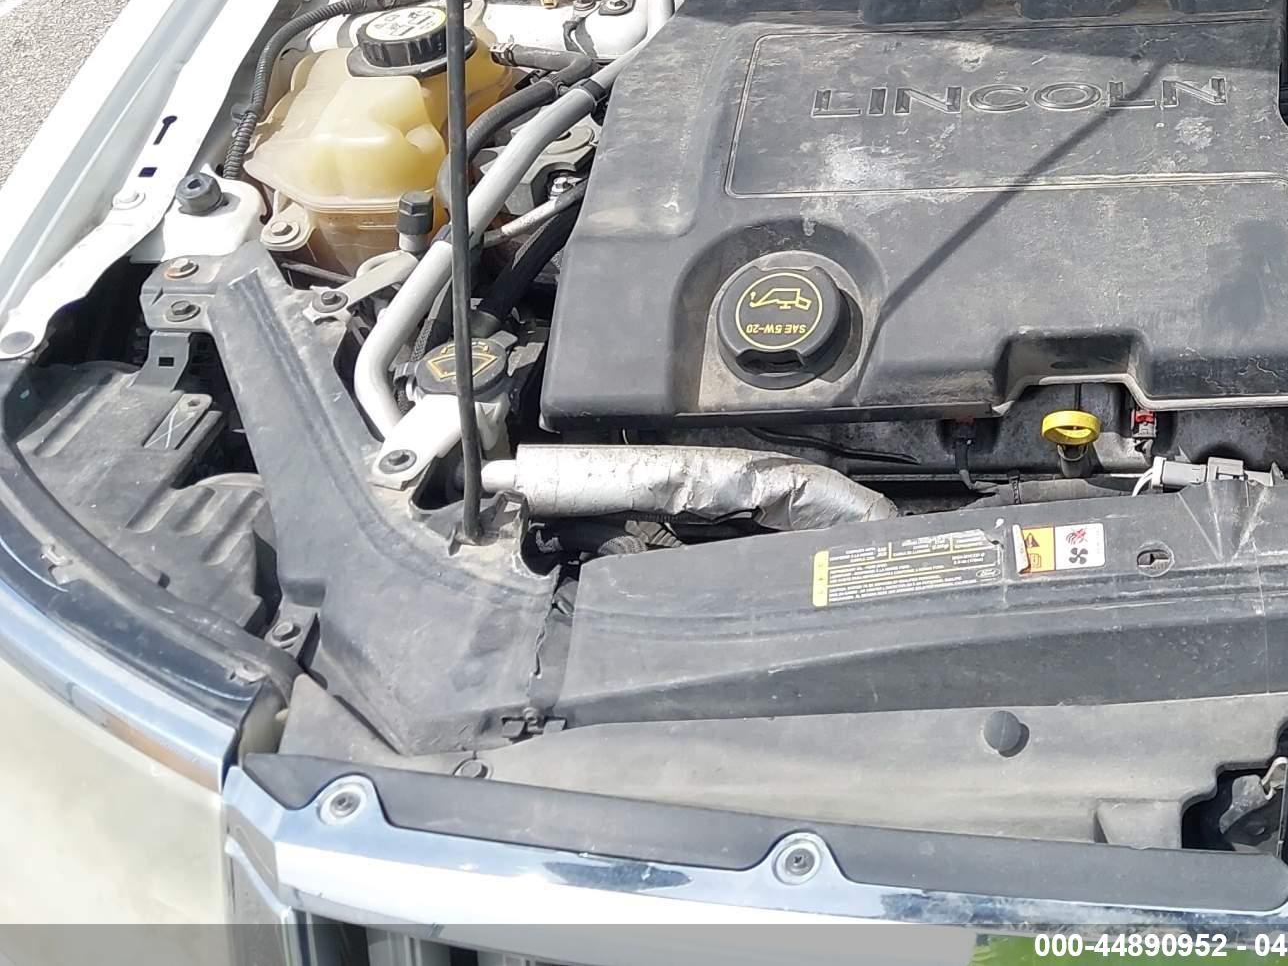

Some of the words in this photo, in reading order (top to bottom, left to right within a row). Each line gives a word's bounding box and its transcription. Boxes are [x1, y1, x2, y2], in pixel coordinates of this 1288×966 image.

[810, 76, 1229, 119] LINCOLN
[745, 323, 783, 335] 5W-20
[783, 323, 808, 334] SAE
